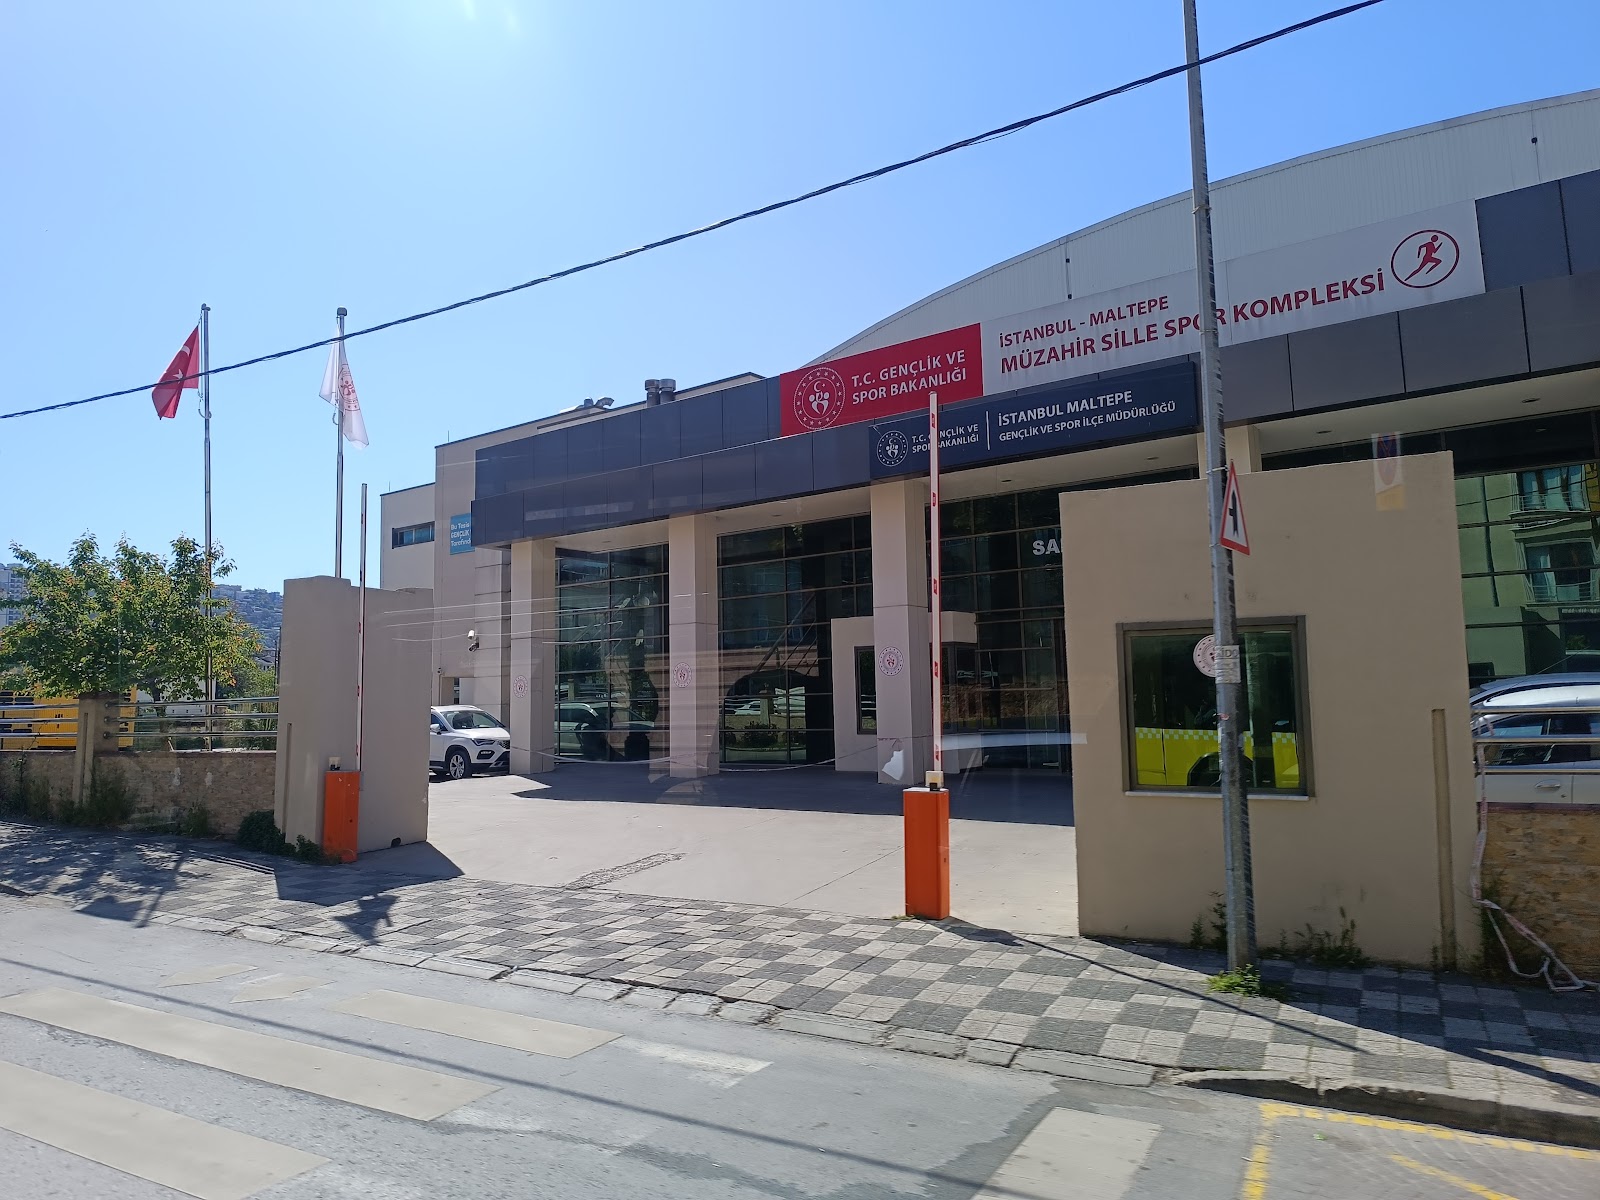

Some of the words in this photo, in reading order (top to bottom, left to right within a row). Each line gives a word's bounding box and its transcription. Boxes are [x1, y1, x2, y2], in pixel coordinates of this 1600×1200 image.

[999, 319, 1076, 348] İSTANBUL
[1090, 296, 1168, 326] MALTEPE
[1001, 337, 1096, 374] MÜZAHİR
[1102, 323, 1158, 352] SİLLE
[1233, 267, 1385, 323] KOMPLEKSİ
[852, 374, 876, 388] T.C.
[879, 355, 942, 380] GENÇLİK
[946, 349, 966, 365] VE
[852, 386, 886, 405] SPOR
[890, 367, 967, 396] BAKANLIĞI
[998, 403, 1064, 427] İSTANBUL
[1066, 390, 1133, 414] MALTEPE
[998, 424, 1039, 442] GENÇLİK
[1040, 422, 1054, 434] VE
[1054, 419, 1081, 432] SPOR
[1082, 414, 1104, 429] İLÇE
[1106, 400, 1176, 424] MÜDÜRLÜĞÜ
[912, 434, 926, 443] T.C.
[966, 424, 978, 433] VE
[938, 433, 979, 448] AKANLIĞI
